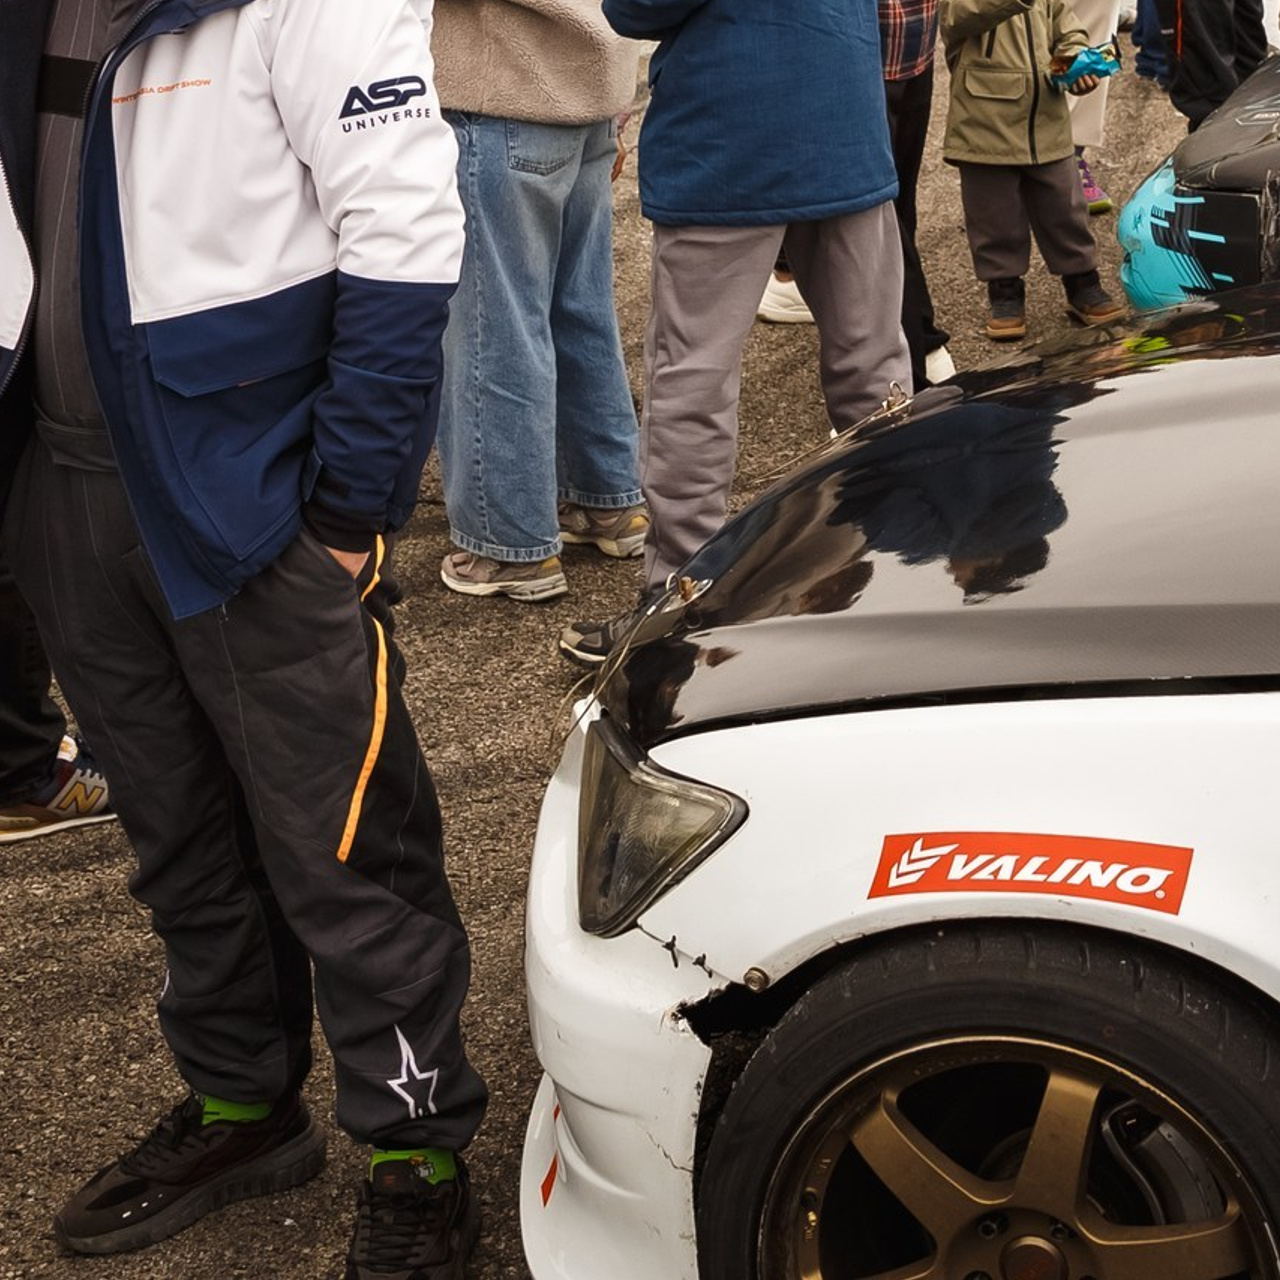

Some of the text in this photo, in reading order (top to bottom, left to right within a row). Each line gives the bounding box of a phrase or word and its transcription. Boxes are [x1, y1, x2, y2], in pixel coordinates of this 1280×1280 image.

[181, 79, 212, 89] SHOW
[338, 75, 427, 120] ASP
[342, 108, 432, 133] UNIVERSE
[947, 853, 1175, 894] VALINO
